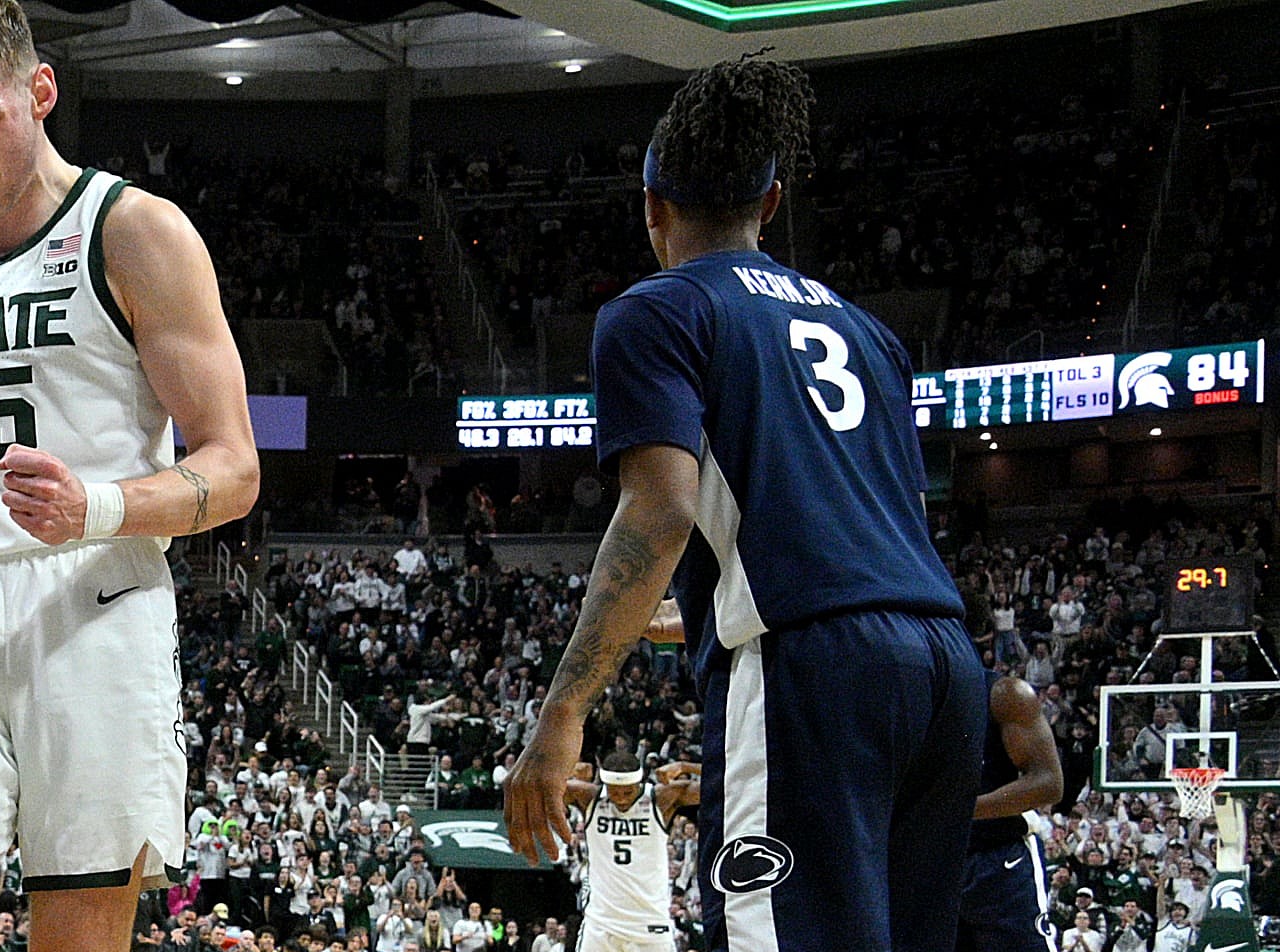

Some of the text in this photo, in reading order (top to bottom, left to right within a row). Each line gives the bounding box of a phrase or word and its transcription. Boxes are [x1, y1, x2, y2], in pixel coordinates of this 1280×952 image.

[732, 266, 805, 304] KERN
[790, 319, 866, 431] 3
[1057, 366, 1102, 382] TOL 3
[1187, 350, 1250, 391] 84
[1055, 392, 1110, 410] FLS 10
[1194, 390, 1240, 405] BONUS
[1177, 567, 1228, 591] 29.7
[597, 816, 650, 836] STATE
[613, 840, 632, 865] 5
